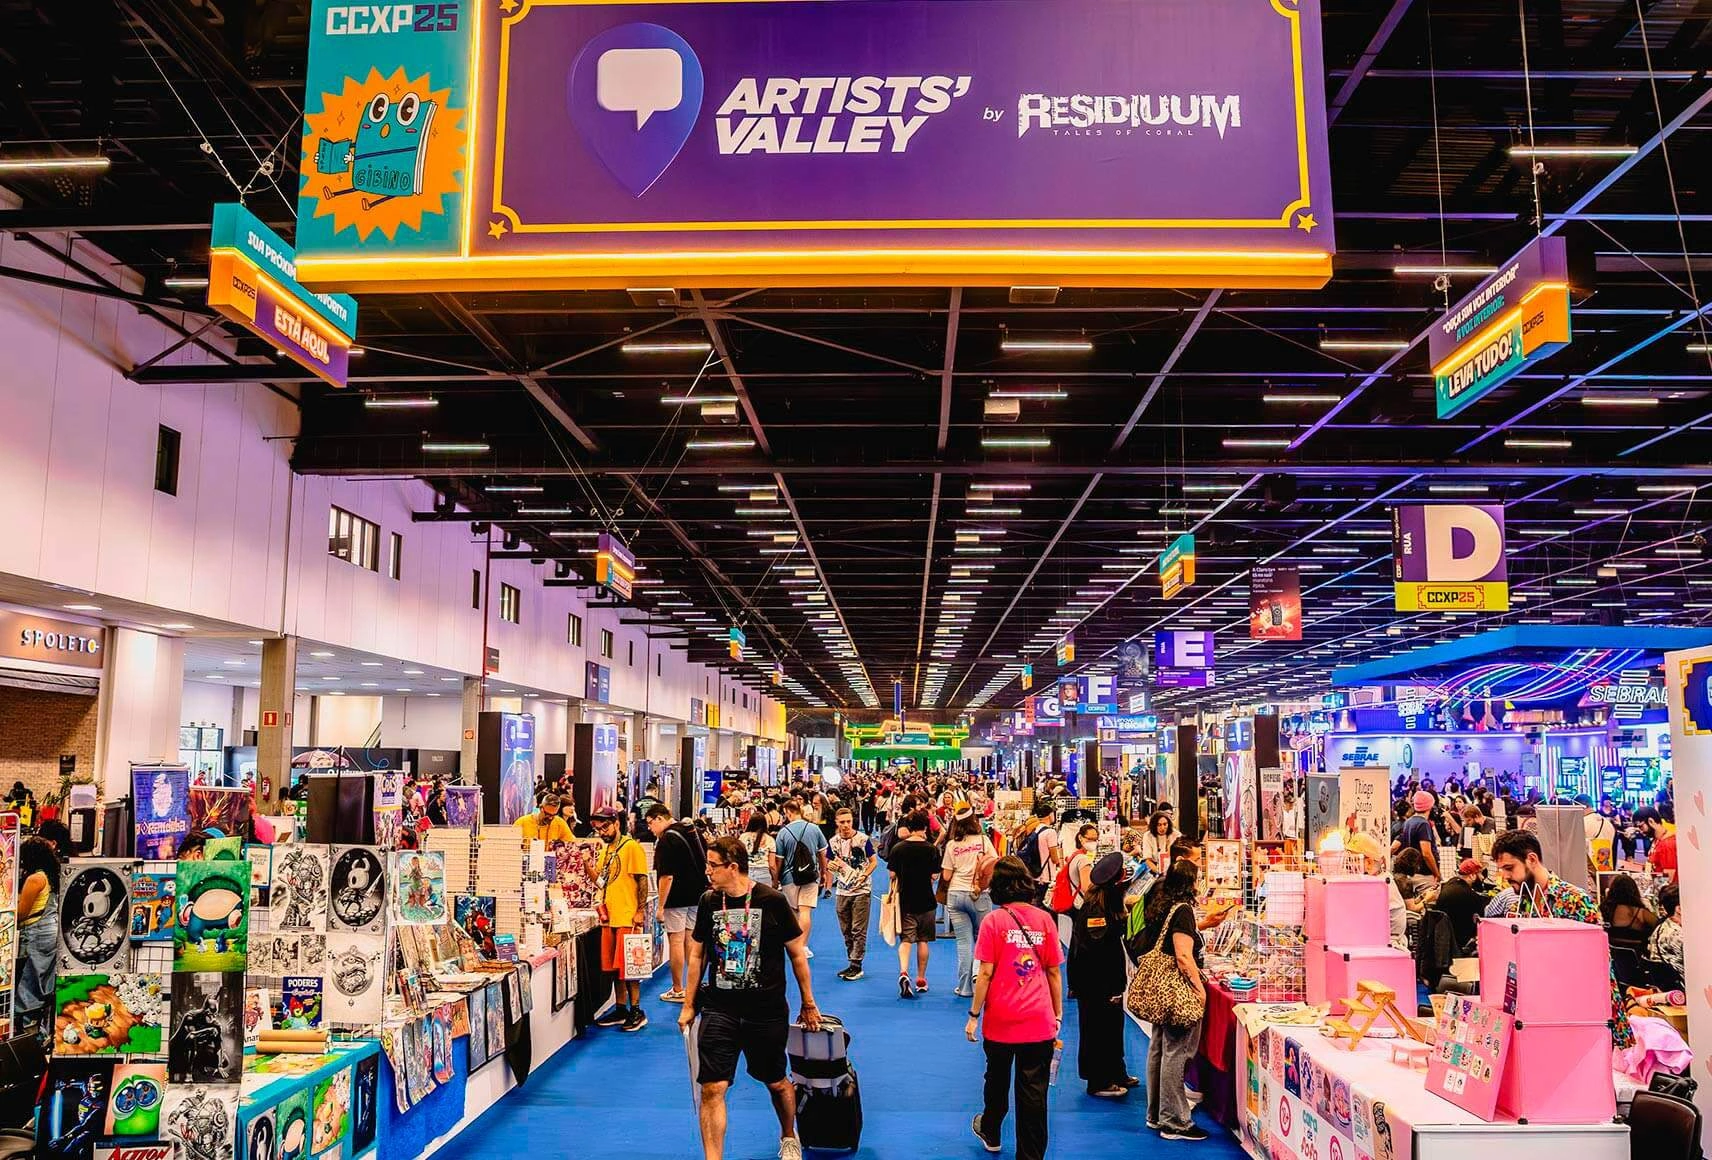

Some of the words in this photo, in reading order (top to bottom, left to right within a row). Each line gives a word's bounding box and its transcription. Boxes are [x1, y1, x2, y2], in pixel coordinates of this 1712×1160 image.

[326, 3, 459, 35] CCXP25
[983, 107, 1004, 122] by
[715, 116, 930, 154] VALLEY
[248, 231, 264, 255] SUA
[265, 250, 297, 281] PRÓXIM
[1461, 302, 1473, 321] SUA
[1472, 291, 1486, 312] VOZ
[274, 304, 302, 344] ESTÁ
[1461, 317, 1474, 337] VOZ
[1448, 361, 1475, 398] LEVA
[1474, 330, 1513, 377] TUDO!
[1403, 532, 1413, 555] RUA
[1424, 504, 1502, 582] D
[1427, 591, 1475, 603] CCXP25
[21, 629, 96, 654] SPOLETO
[1174, 632, 1205, 667] E
[1088, 676, 1113, 703] F
[1043, 697, 1061, 717] G
[1342, 753, 1379, 761] SEBRAE
[288, 979, 318, 988] PODERES
